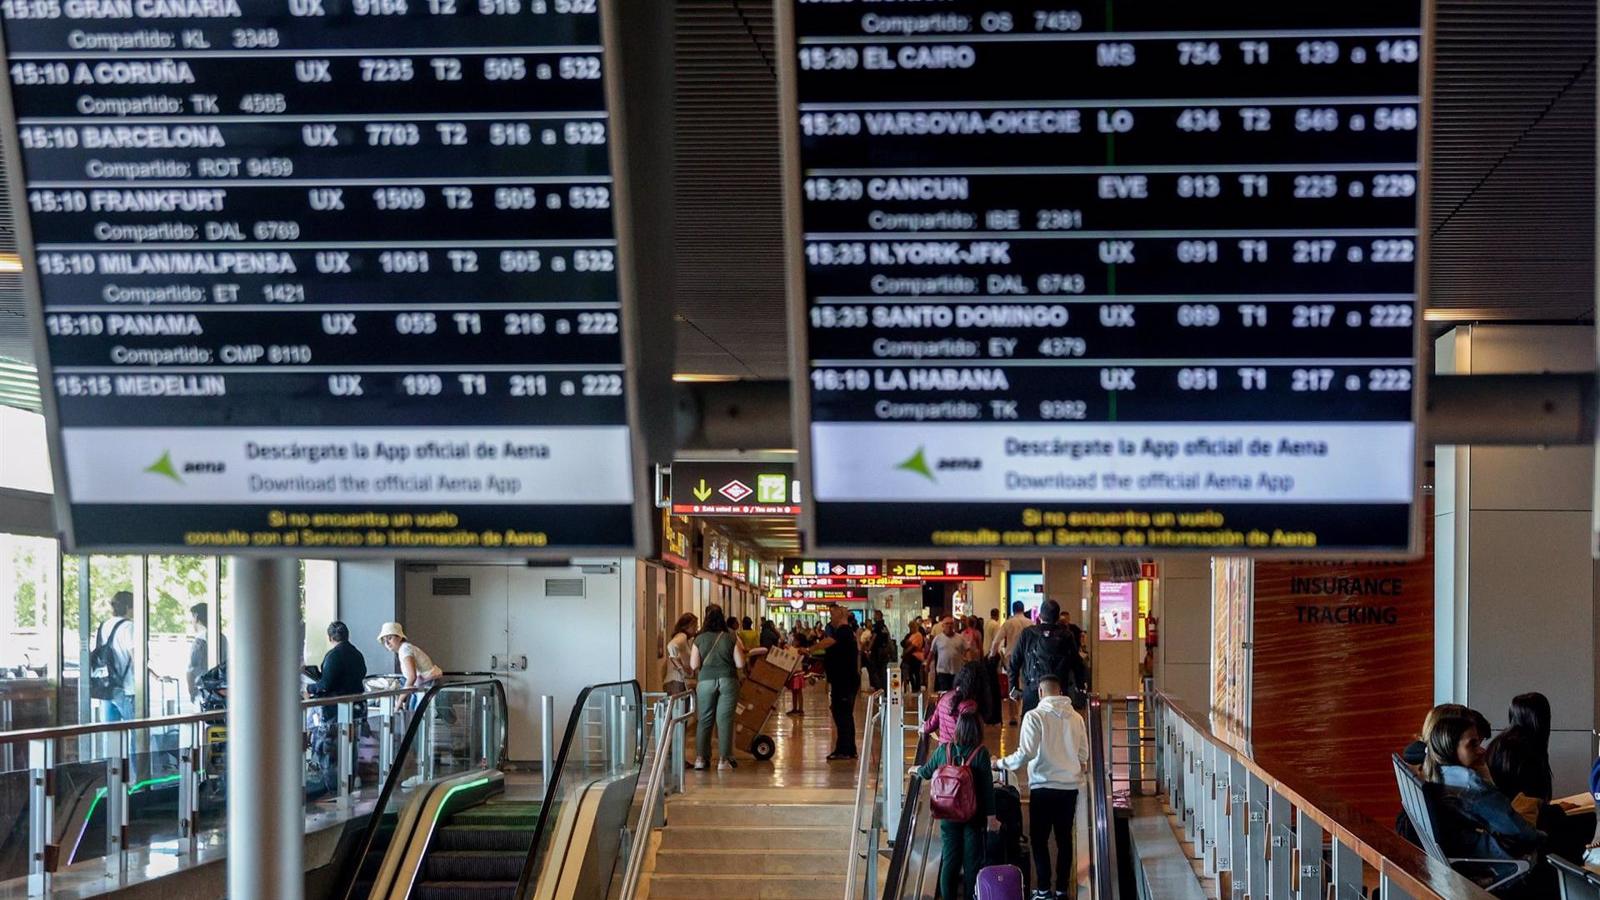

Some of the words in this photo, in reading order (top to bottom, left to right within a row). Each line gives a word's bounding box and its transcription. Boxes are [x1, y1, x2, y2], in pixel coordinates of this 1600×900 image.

[63, 0, 133, 18] GRAN
[135, 0, 241, 17] CANARIA
[290, 0, 325, 16] UX
[430, 0, 456, 14] T2
[861, 12, 972, 36] Compartido:
[981, 12, 1013, 32] OS
[69, 29, 176, 51] Compartido:
[182, 30, 210, 48] KL
[863, 47, 896, 69] EL
[898, 46, 975, 68] CAIRO
[1097, 44, 1135, 66] MS
[1178, 42, 1220, 65] 754
[1240, 42, 1268, 64] T1
[11, 63, 69, 84] 15:10
[74, 63, 93, 84] A
[93, 59, 194, 83] CORUÑA
[296, 60, 331, 82] UX
[360, 59, 413, 81] 7235
[431, 58, 462, 80] T2
[485, 58, 526, 80] 505
[77, 94, 184, 117] Compartido:
[191, 95, 219, 113] TK
[865, 110, 1080, 134] VARSOVIA-OKECIE
[1098, 110, 1133, 132] LO
[1240, 108, 1270, 130] T2
[21, 128, 78, 148] 15:10
[82, 127, 225, 147] BARCELONA
[303, 125, 338, 146] UX
[366, 124, 419, 145] 7703
[437, 123, 467, 144] T2
[490, 124, 531, 145] 516
[86, 159, 191, 181] Compartido:
[199, 158, 241, 177] ROT
[247, 158, 293, 176] 9459
[868, 177, 968, 200] CANCUN
[1099, 176, 1147, 198] EVE
[1239, 175, 1267, 196] T1
[1294, 175, 1337, 197] 225
[30, 191, 86, 211] 15:10
[91, 189, 226, 211] FRANKFURT
[309, 189, 344, 210] UX
[373, 188, 425, 209] 1509
[442, 187, 473, 209] T2
[495, 188, 536, 209] 505
[95, 221, 199, 243] Compartido:
[206, 222, 246, 240] DAL
[868, 210, 977, 233] Compartido:
[39, 254, 95, 274] 15:10
[100, 252, 296, 274] MILAN/MALPENSA
[316, 252, 350, 273] UX
[448, 251, 478, 272] T2
[500, 251, 541, 272] 505
[806, 243, 866, 264] 15:35
[870, 242, 1010, 264] N.YORK-JFK
[1099, 241, 1134, 263] UX
[1239, 240, 1267, 262] T1
[1293, 240, 1336, 262] 217
[1371, 240, 1414, 262] 222
[103, 284, 206, 305] Compartido:
[213, 284, 239, 302] ET
[264, 284, 304, 302] 1421
[871, 274, 978, 296] Compartido:
[987, 275, 1026, 294] DAL
[48, 315, 103, 335] 15:10
[107, 314, 202, 335] PANAMA
[322, 313, 357, 334] UX
[396, 313, 436, 334] 055
[454, 313, 481, 334] T1
[578, 313, 618, 334] 222
[811, 306, 868, 327] 15:35
[873, 306, 952, 327] SANTO
[956, 306, 1068, 327] DOMINGO
[1100, 305, 1134, 326] UX
[1239, 304, 1266, 326] T1
[1293, 305, 1335, 327] 217
[1370, 305, 1413, 326] 222
[110, 346, 214, 366] Compartido:
[221, 345, 263, 363] CMP
[873, 338, 980, 360] Compartido:
[989, 338, 1017, 356] EY
[57, 376, 111, 395] 15:15
[115, 376, 225, 395] MEDELLIN
[329, 375, 363, 395] UX
[403, 374, 442, 395] 199
[459, 374, 486, 394] T1
[510, 375, 546, 395] 211
[583, 375, 622, 395] 222
[875, 370, 908, 390] LA
[908, 369, 1008, 390] HABANA
[1101, 369, 1135, 390] UX
[1238, 368, 1266, 389] T1
[1292, 369, 1334, 391] 217
[1369, 369, 1411, 390] 222
[875, 400, 982, 422] Compartido:
[992, 401, 1017, 420] TK
[246, 442, 347, 463] Descárgate
[353, 443, 369, 459] la
[376, 443, 410, 461] App
[415, 442, 470, 459] oficial
[477, 443, 496, 459] de
[503, 442, 550, 459] Aena
[1005, 438, 1113, 459] Descárgate
[1119, 439, 1136, 456] la
[1141, 439, 1179, 458] App
[1184, 438, 1242, 456] oficial
[1250, 440, 1271, 456] de
[1277, 439, 1328, 456] Aena
[184, 462, 225, 473] aena
[936, 459, 982, 470] aena
[249, 475, 336, 492] Download
[340, 476, 369, 492] the
[375, 475, 432, 492] official
[437, 475, 481, 492] Aena
[486, 475, 521, 494] App
[760, 479, 785, 500] T2
[1005, 471, 1097, 489] Download
[1102, 473, 1133, 489] the
[1138, 473, 1199, 489] official
[1204, 473, 1252, 489] Aena
[1257, 473, 1294, 492] App
[414, 512, 458, 527] vuelo
[185, 531, 250, 545] consulte
[301, 529, 363, 546] Servicio
[388, 528, 479, 545] Información
[505, 531, 547, 545] Aena
[1290, 577, 1402, 595] INSURANCE
[1296, 606, 1397, 624] TRACKING
